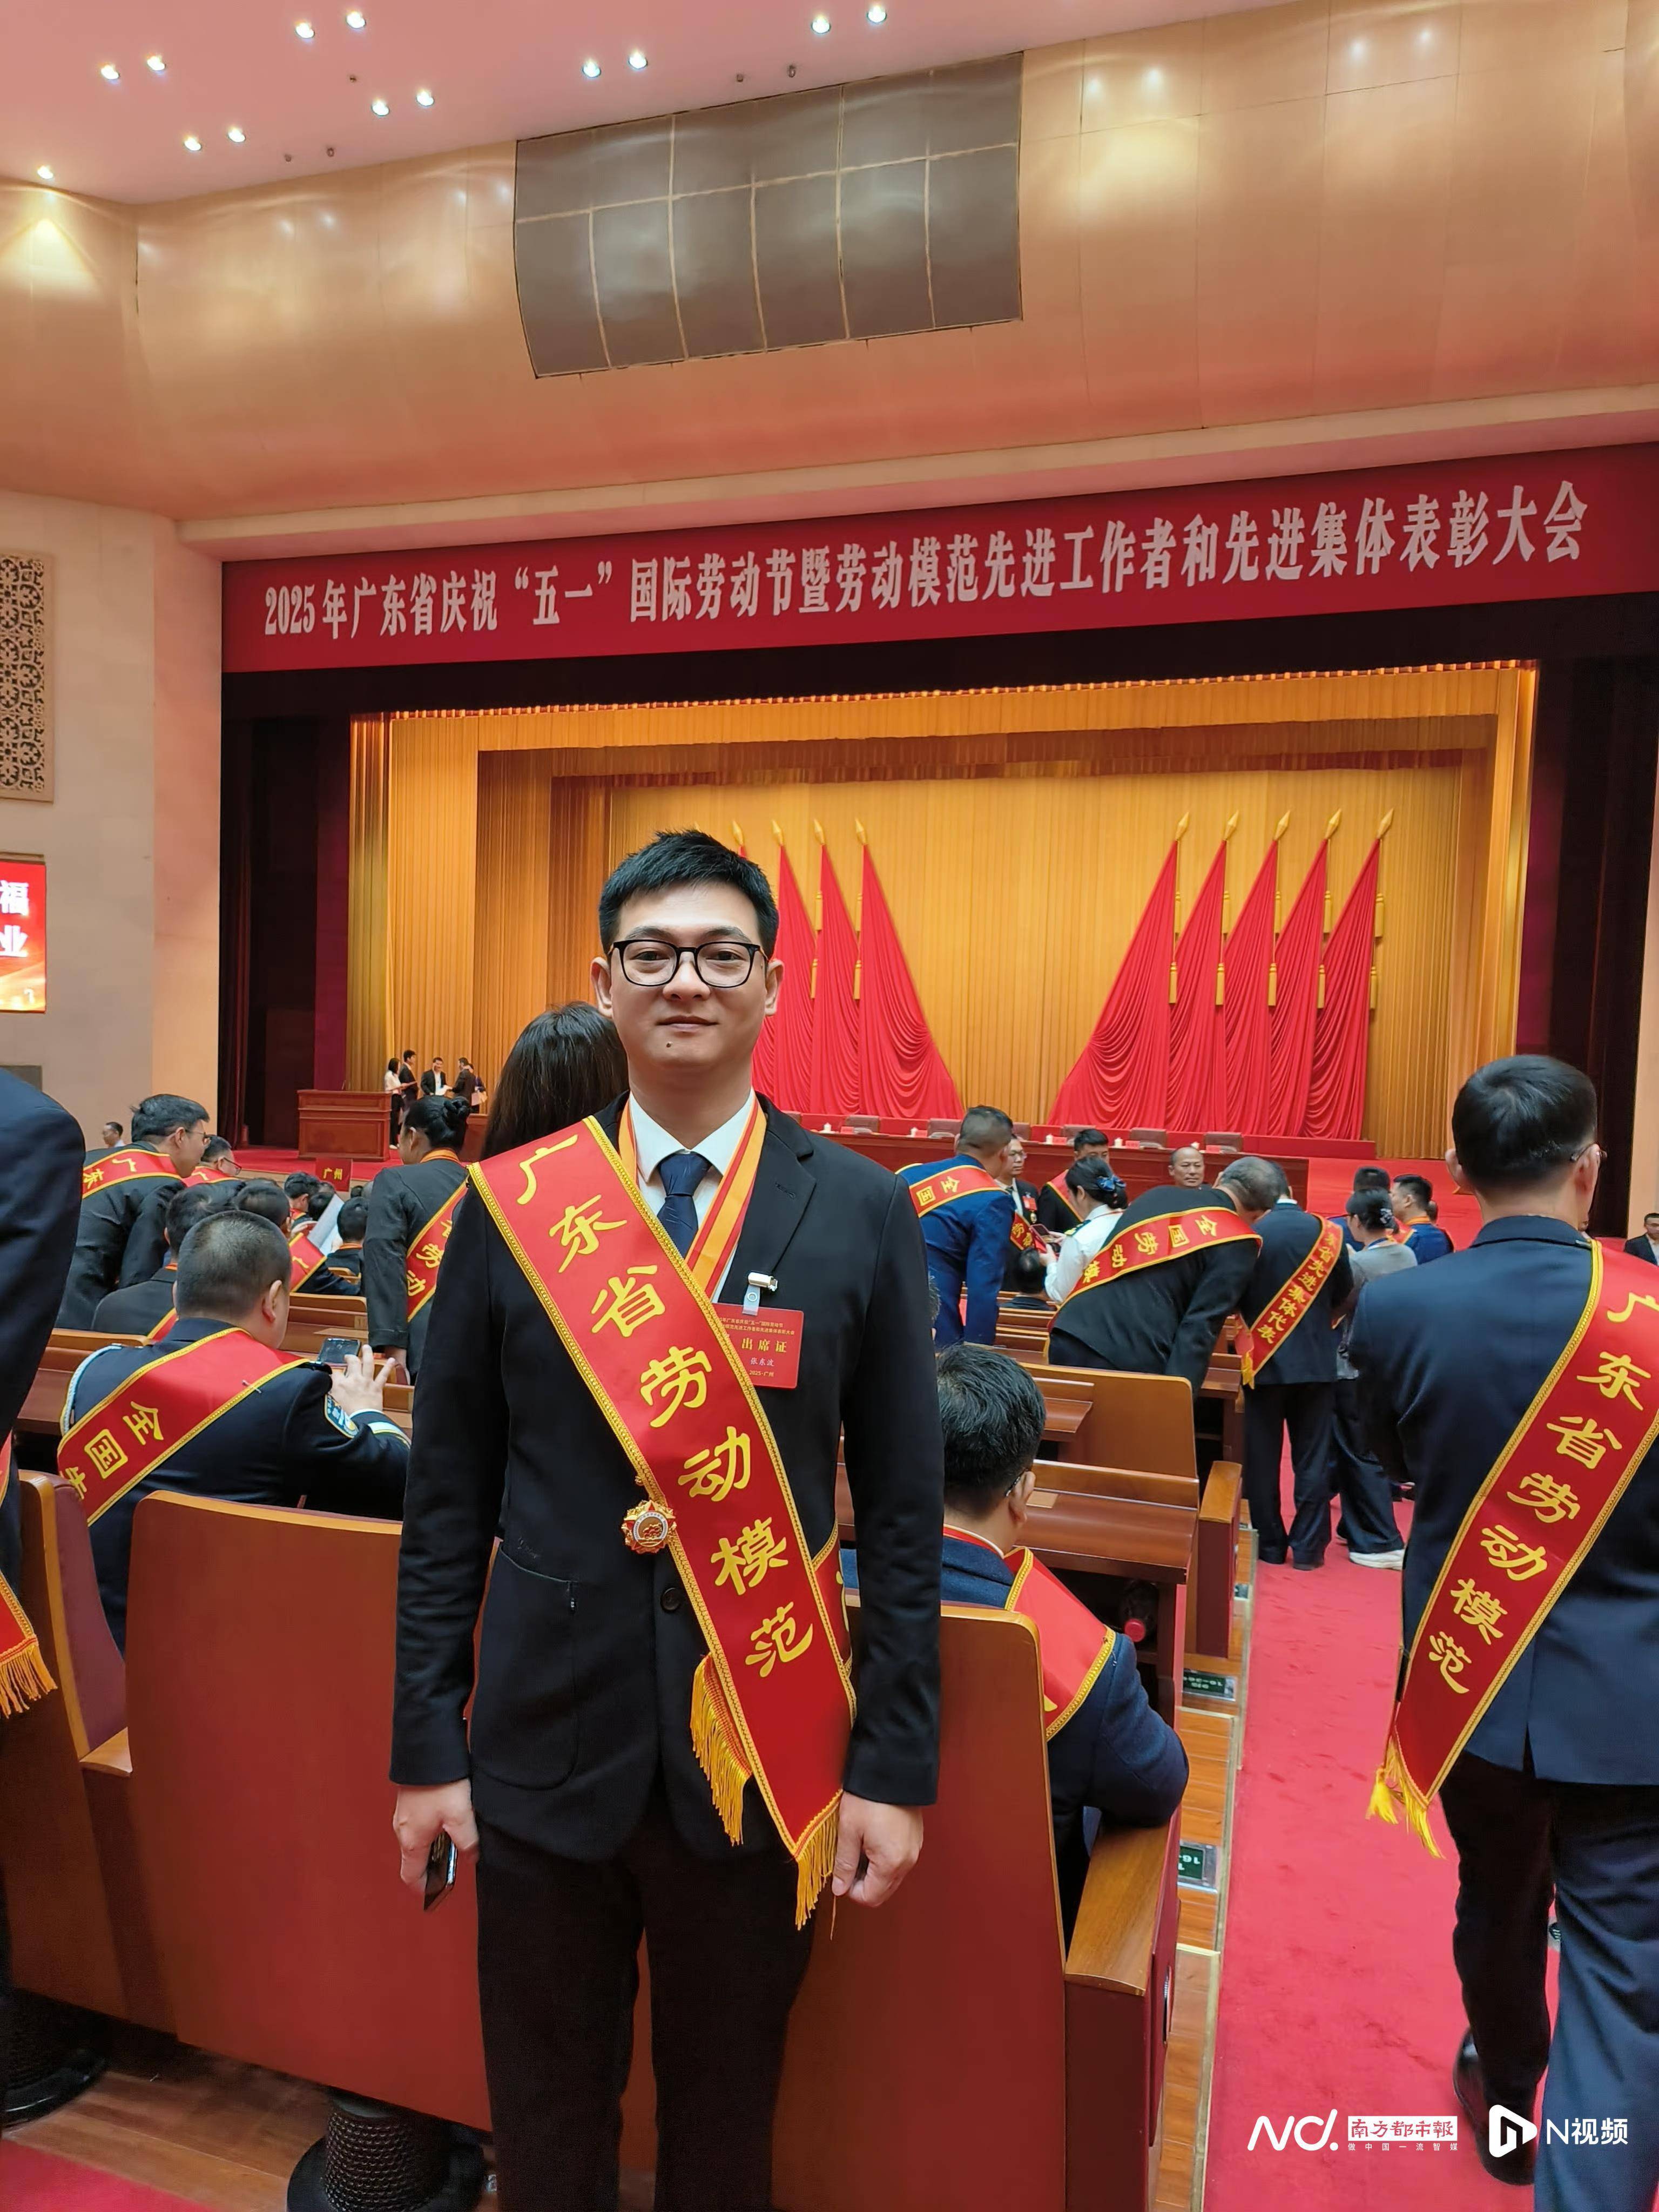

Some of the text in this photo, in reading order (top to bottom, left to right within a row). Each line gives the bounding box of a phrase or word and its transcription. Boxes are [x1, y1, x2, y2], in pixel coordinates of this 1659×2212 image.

[323, 1167, 343, 1180] 广州
[916, 1176, 960, 1206] 全国
[742, 1338, 787, 1352] 出席证
[750, 1357, 774, 1367] 张东波
[517, 1134, 813, 1677] 广东省劳动模范
